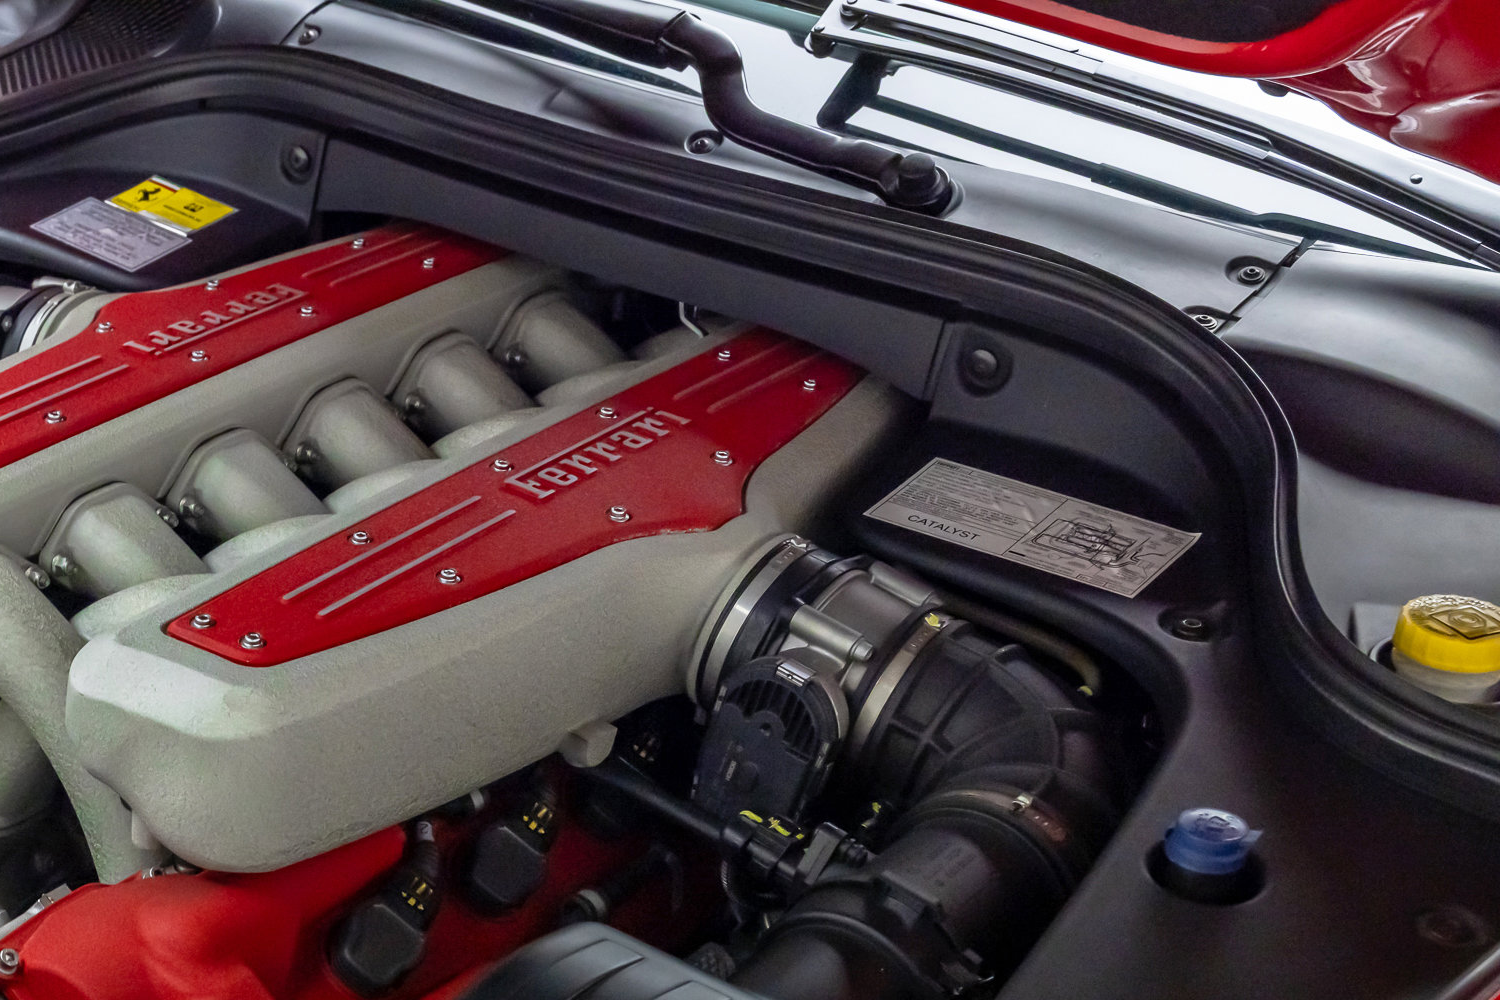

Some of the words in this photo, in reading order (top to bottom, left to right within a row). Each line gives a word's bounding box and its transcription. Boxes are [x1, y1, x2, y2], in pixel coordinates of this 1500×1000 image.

[122, 283, 308, 356] Ferrari
[504, 406, 693, 499] Ferrari
[906, 513, 982, 542] CATALYST
